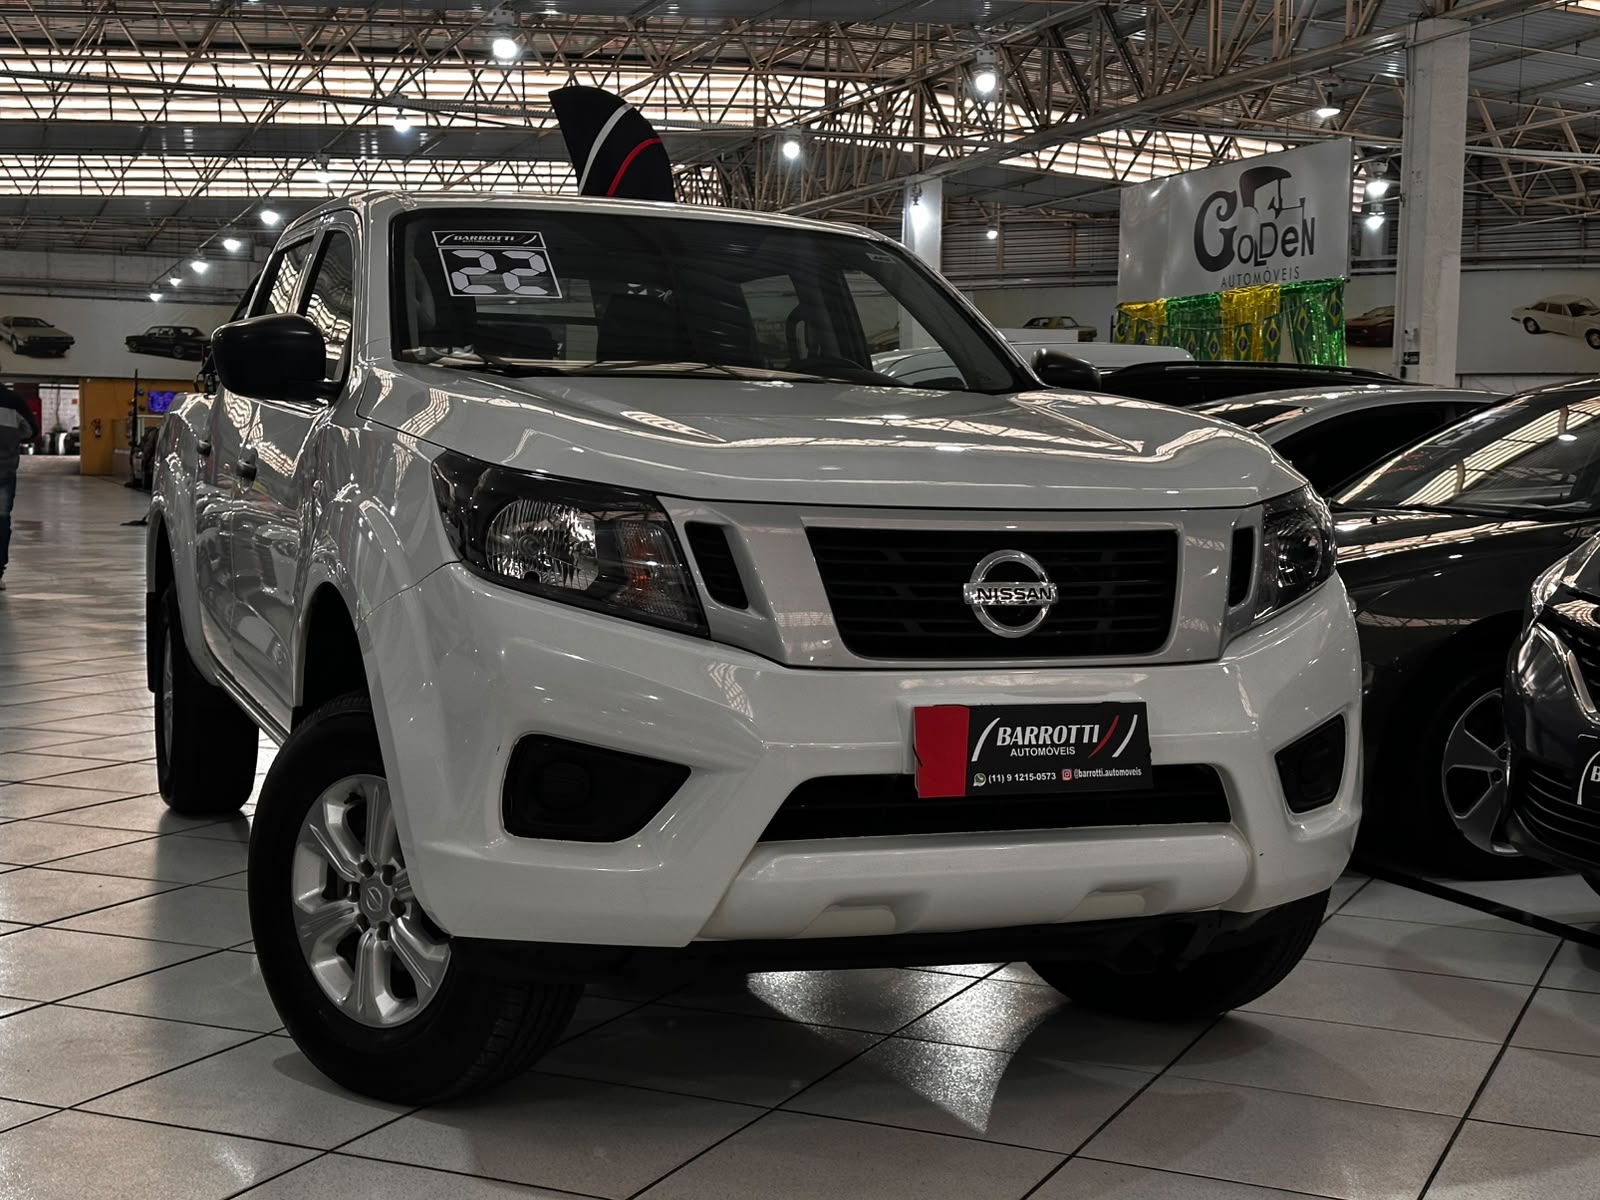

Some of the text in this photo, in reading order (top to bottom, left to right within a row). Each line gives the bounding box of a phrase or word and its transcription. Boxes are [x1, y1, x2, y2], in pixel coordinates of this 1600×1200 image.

[451, 249, 549, 295] 22
[1221, 266, 1300, 288] AUTOMÓVEIS
[976, 587, 1052, 600] NISSAN
[996, 724, 1100, 746] BARROTTI
[1010, 745, 1076, 757] AUTOMÓVEIS
[988, 774, 1005, 783] (11)
[1006, 774, 1012, 782] 9
[1014, 772, 1057, 781] 1215-0573
